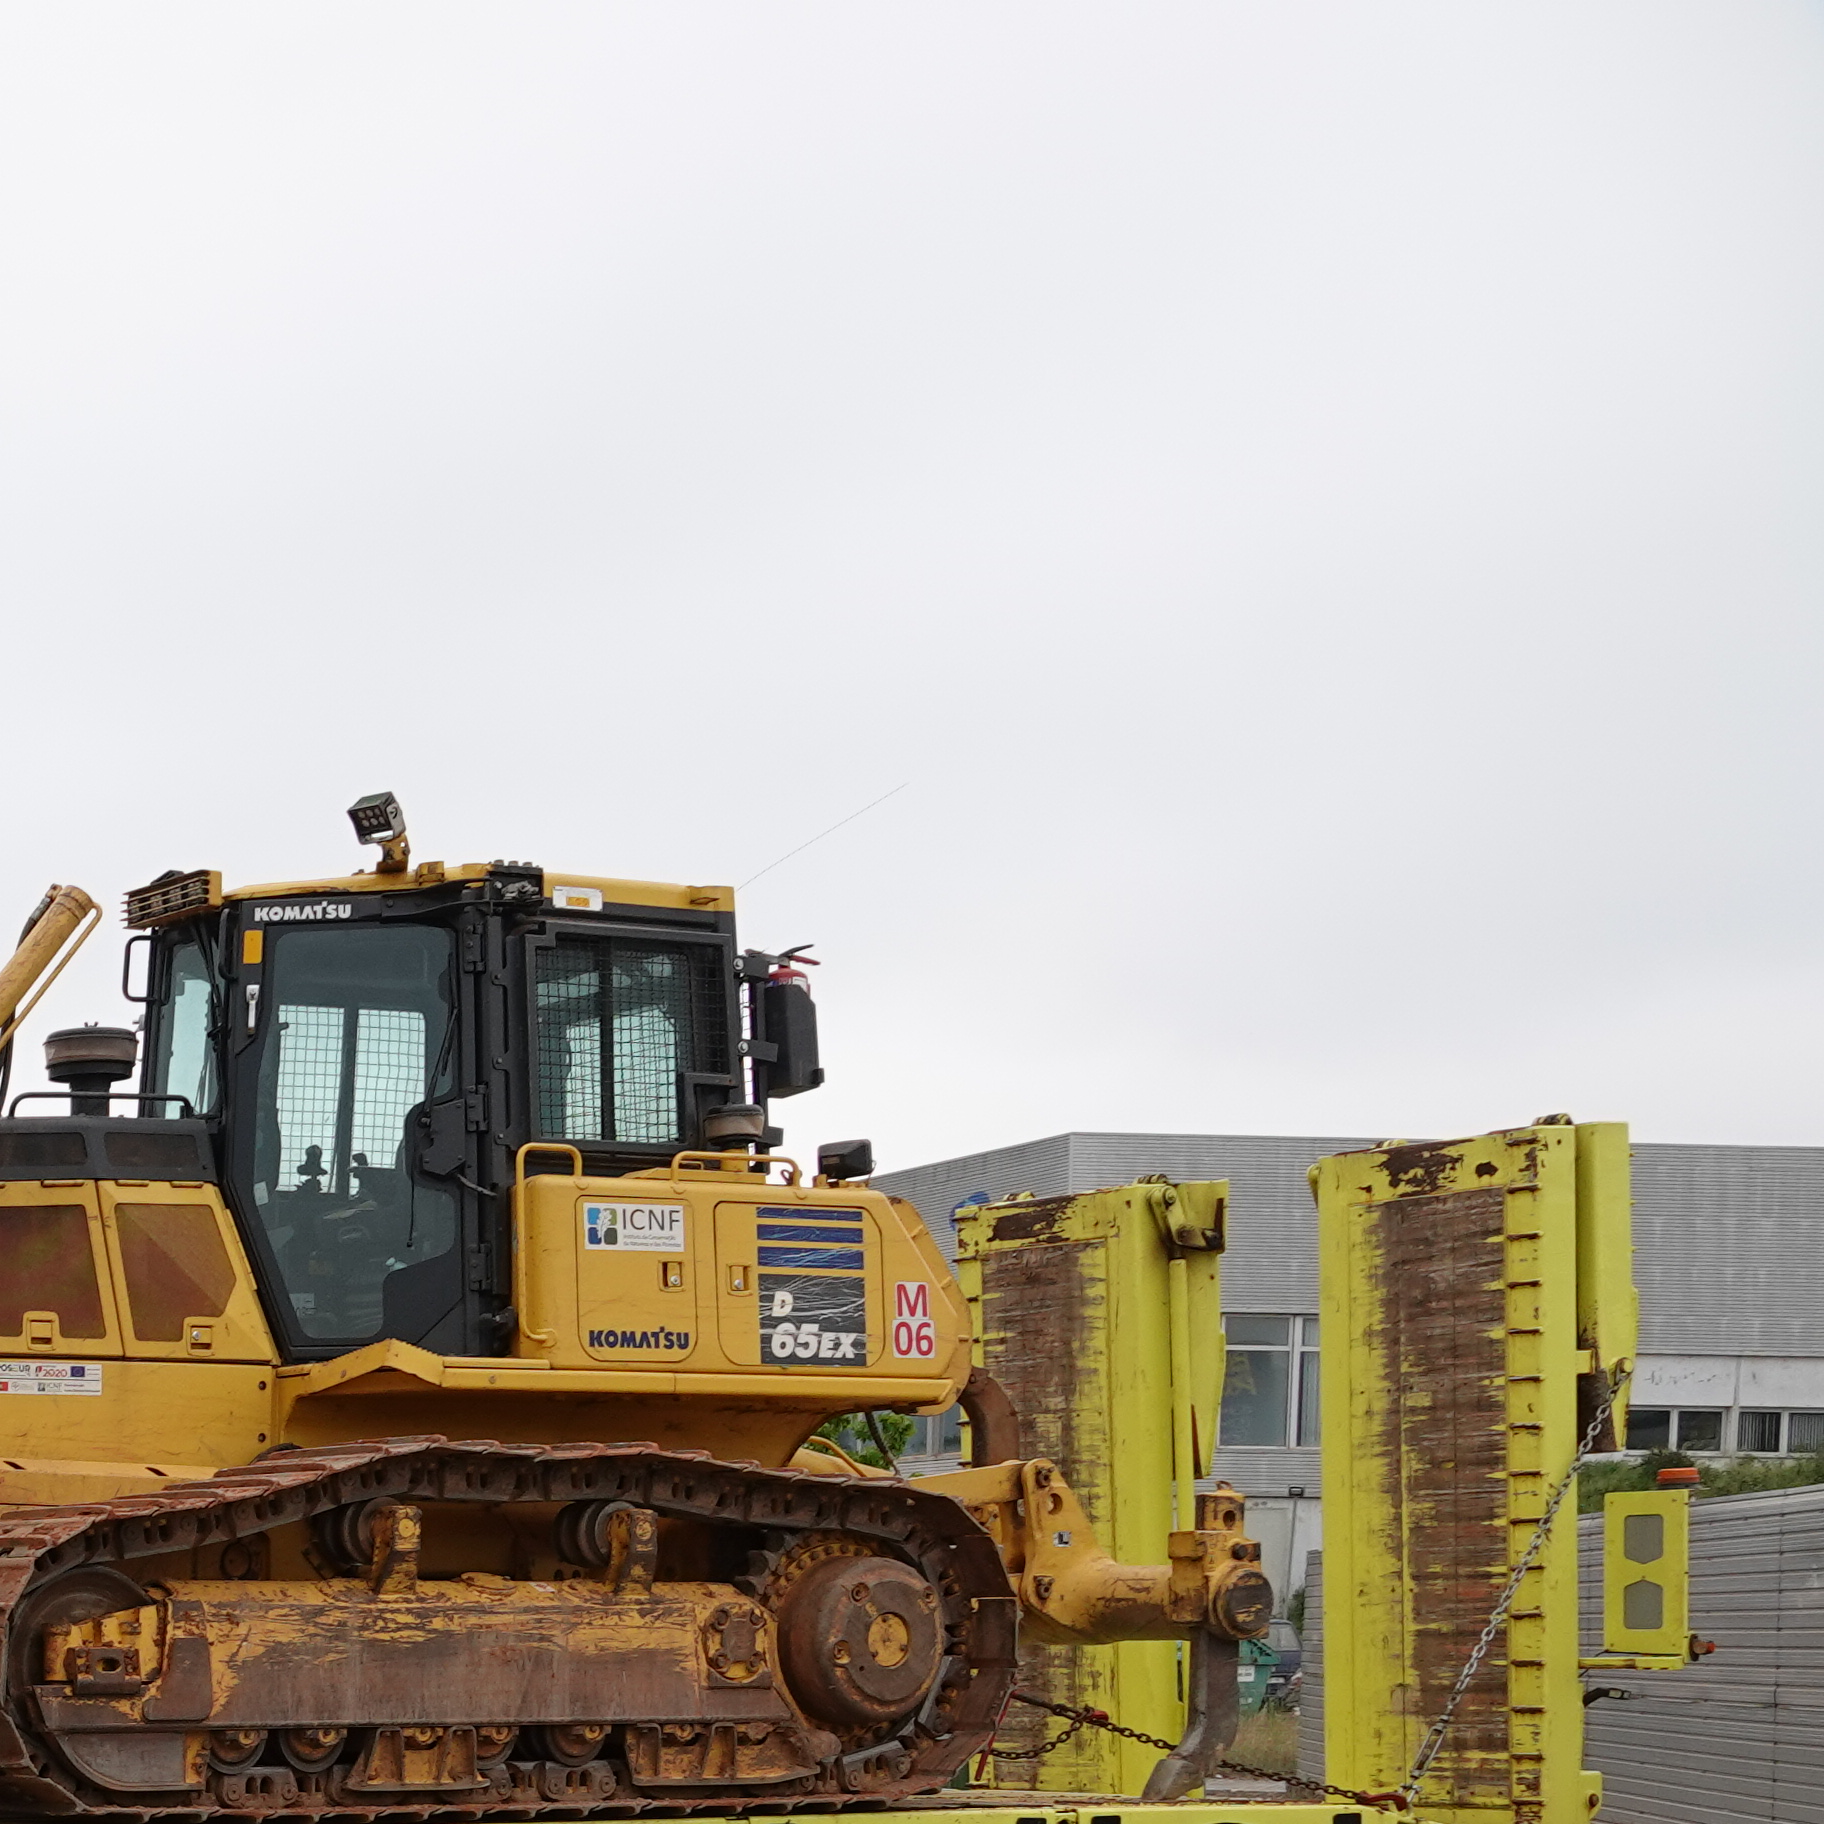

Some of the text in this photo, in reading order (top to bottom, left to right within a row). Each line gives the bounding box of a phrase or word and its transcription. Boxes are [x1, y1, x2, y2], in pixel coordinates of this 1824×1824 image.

[254, 900, 352, 922] KOMATSU
[622, 1208, 681, 1231] ICNF
[771, 1290, 794, 1318] D
[896, 1283, 929, 1319] M
[588, 1326, 690, 1350] KOMATSU
[770, 1322, 859, 1360] 65EX
[894, 1321, 934, 1357] 06
